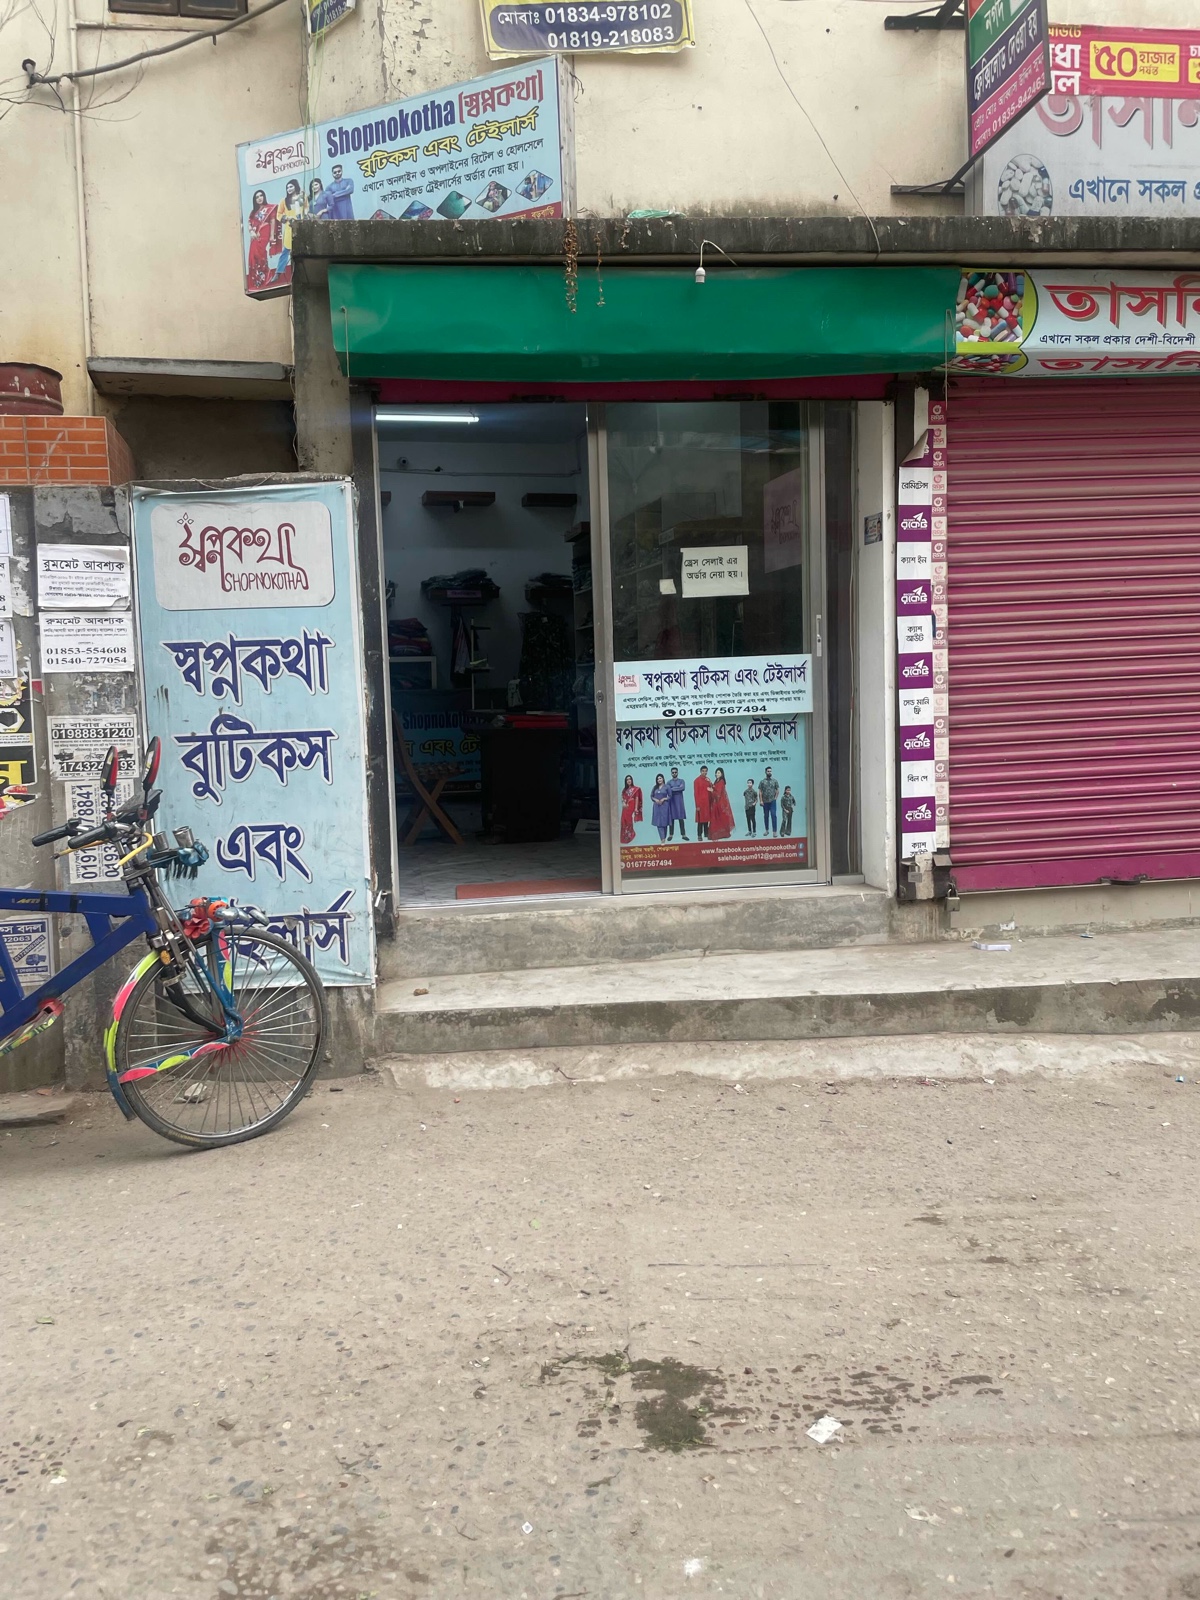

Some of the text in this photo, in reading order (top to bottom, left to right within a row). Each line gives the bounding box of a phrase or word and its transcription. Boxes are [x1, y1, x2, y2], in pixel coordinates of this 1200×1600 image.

[545, 3, 672, 24] 01834-978102
[547, 26, 675, 49] 01819-218083
[1139, 50, 1177, 65] হাজার
[1138, 65, 1159, 76] পর্যন্ত
[326, 100, 456, 158] Shopnokotha
[357, 105, 540, 178] বুটিকস এবং টেইলার্স
[362, 179, 385, 193] এখানে
[386, 171, 418, 186] অনলাইন
[419, 169, 426, 178] ও
[496, 149, 504, 158] ও
[463, 167, 486, 182] অর্ডার
[1069, 176, 1131, 203] এখানে
[1137, 180, 1188, 204] সকল
[1040, 332, 1196, 346] এখানে সকল প্রকার দেশী-বিদেশী
[42, 558, 126, 571] রুমমেট আবশ্যক
[701, 556, 723, 567] সেলাই
[726, 557, 738, 565] এর
[900, 555, 927, 564] ক্যাশ ইন
[686, 569, 707, 580] অর্ডার
[224, 571, 303, 592] SHOPNOKOTHA
[44, 616, 124, 625] রুমমেট আবশ্যক
[907, 625, 922, 633] ক্যাশ
[46, 647, 127, 655] 01853-554608
[47, 657, 127, 665] 01540-727054
[161, 628, 335, 705] স্বপ্নকথা
[642, 669, 686, 693] স্বপ্নকথা
[689, 665, 730, 691] বুটিকস
[735, 669, 760, 686] এবং
[763, 660, 808, 685] টেইলার্স
[916, 696, 929, 705] মানি
[679, 705, 767, 716] 01677567494
[52, 728, 134, 739] 01988831240
[664, 719, 710, 750] বুটিকস
[715, 723, 745, 745] এবং
[748, 713, 799, 744] টেইলার্স
[172, 714, 338, 804] বুটিকস
[907, 773, 920, 782] বিল
[911, 841, 927, 849] ক্যাশ
[215, 823, 313, 884] এবং
[626, 860, 673, 868] 01677567494
